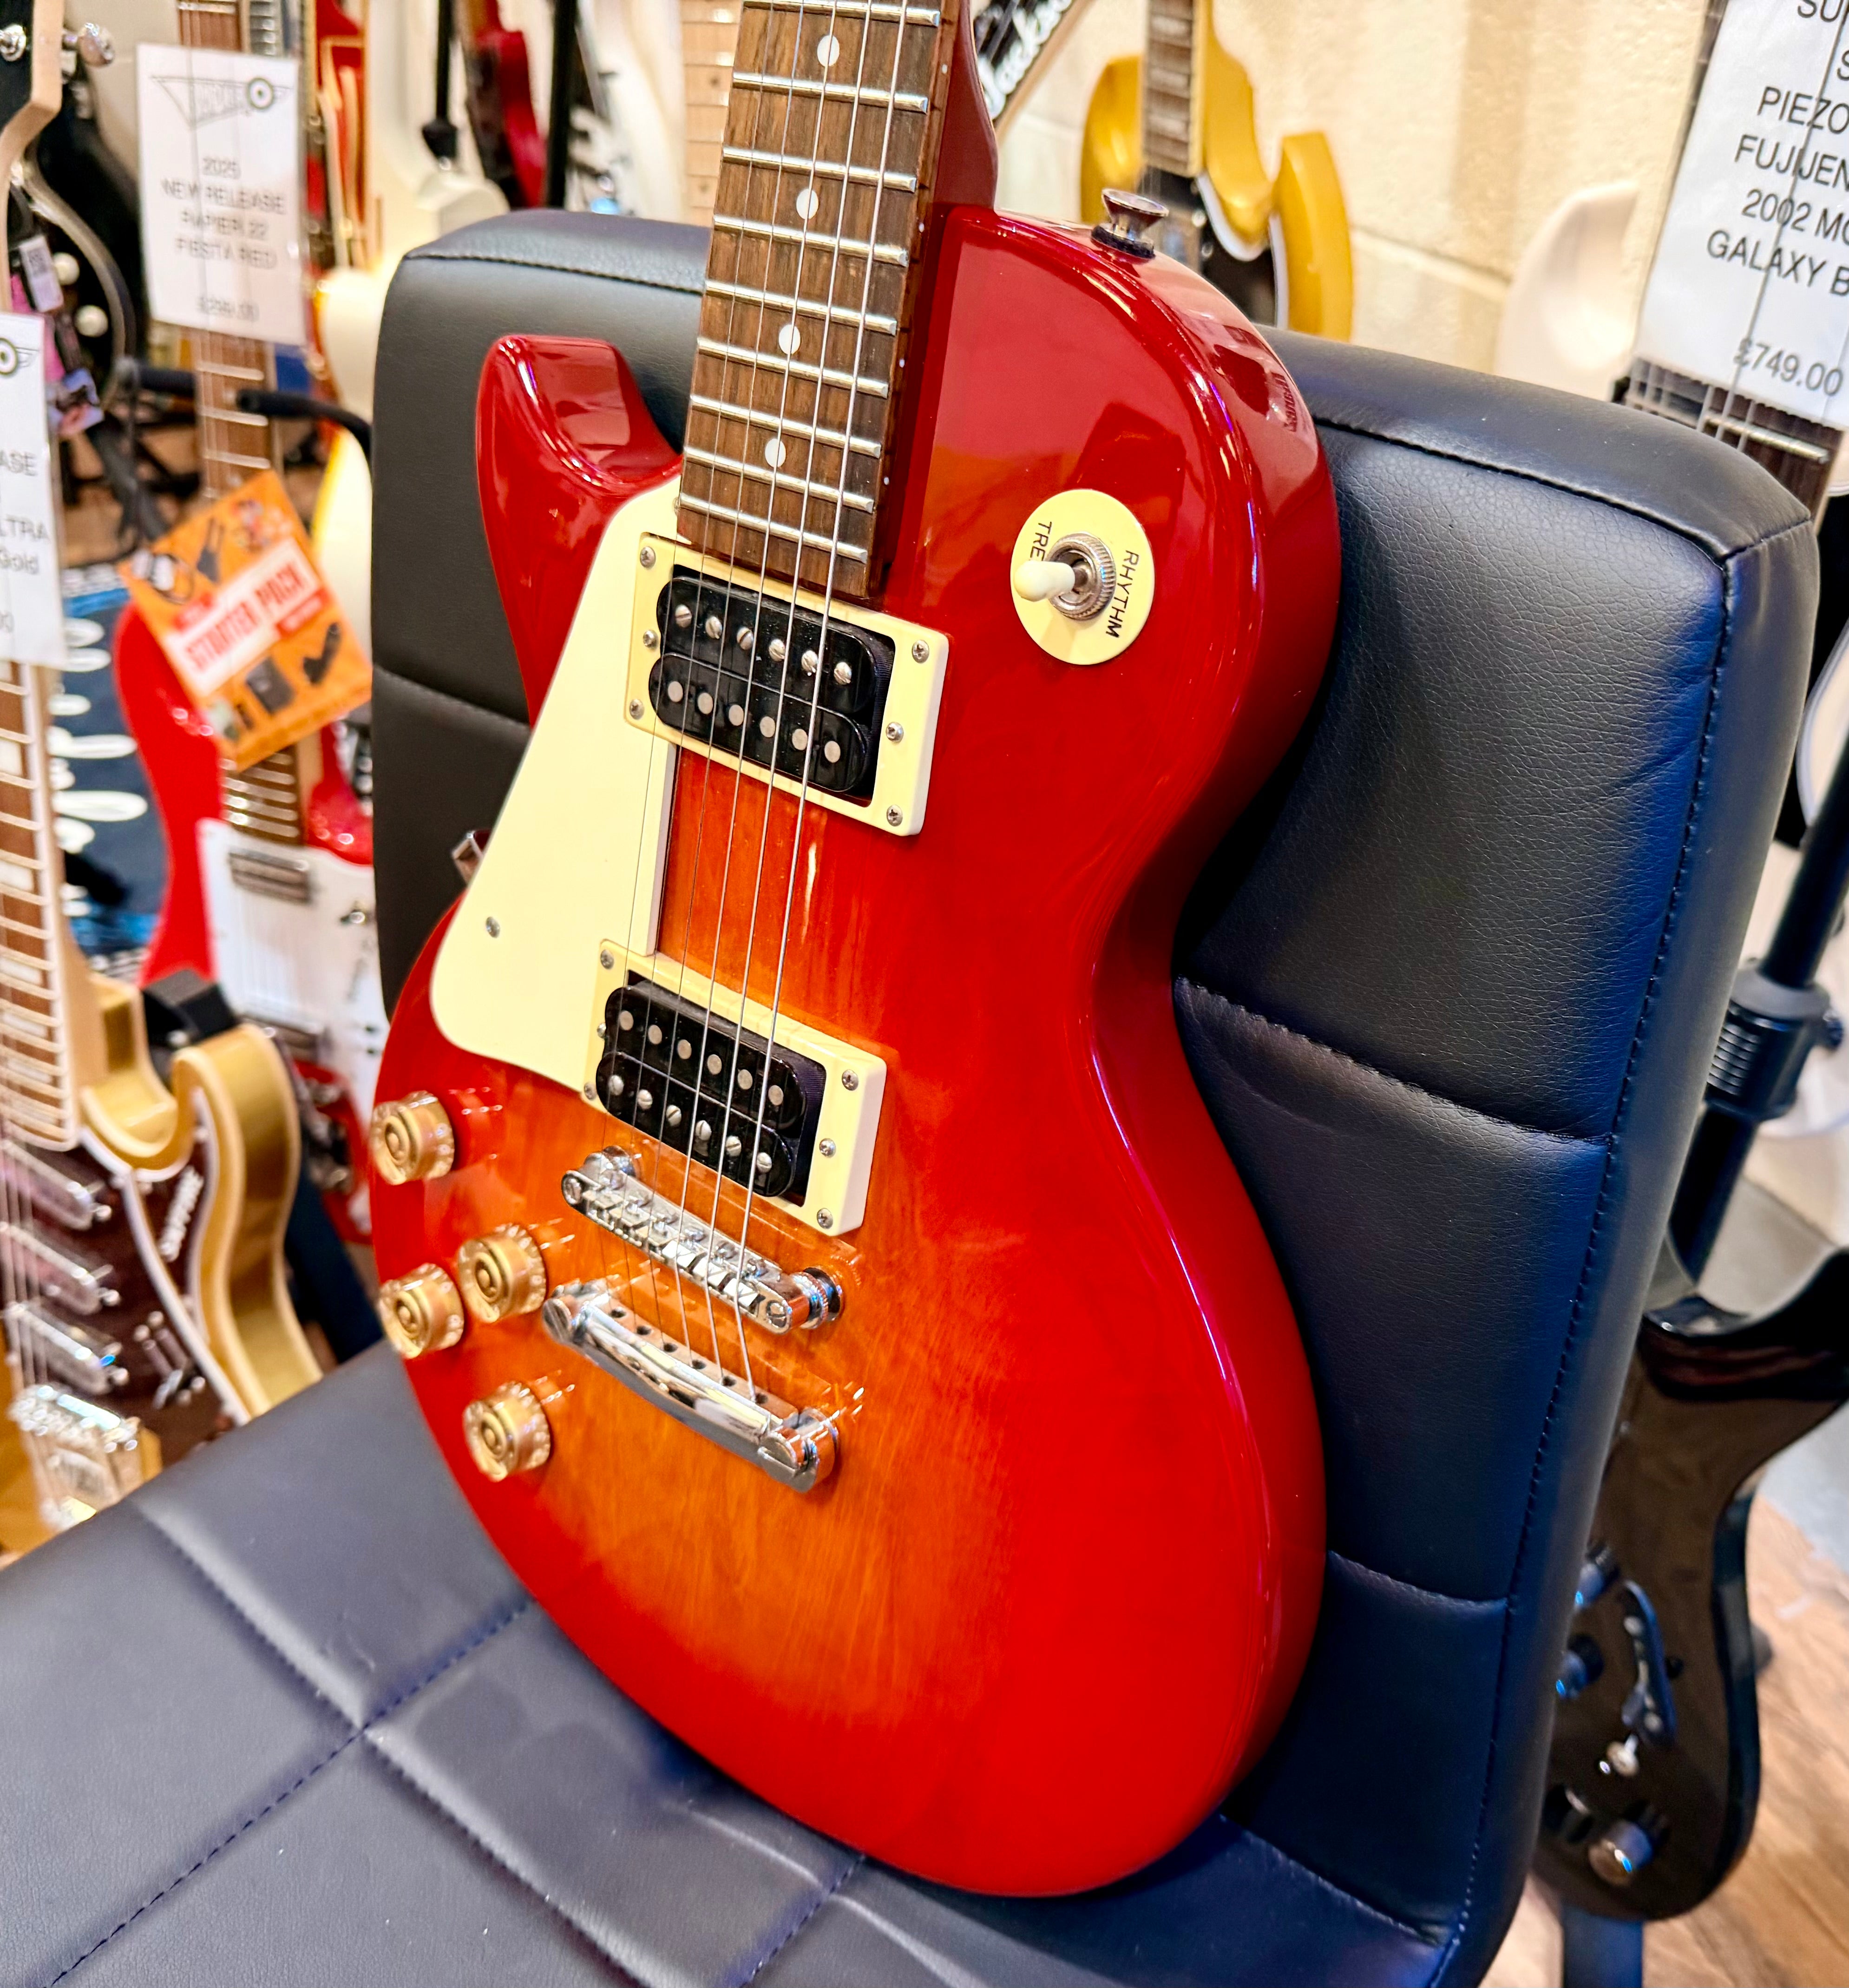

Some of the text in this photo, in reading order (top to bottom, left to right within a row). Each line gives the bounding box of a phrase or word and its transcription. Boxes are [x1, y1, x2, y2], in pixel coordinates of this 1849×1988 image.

[1798, 0, 1849, 22] SU
[1757, 85, 1849, 134] PIEZO
[203, 156, 241, 180] 2025
[1742, 188, 1812, 232] 2002
[1707, 230, 1827, 288] GALAXY
[1733, 338, 1843, 396] £749.00
[1105, 550, 1140, 638] RHYTHM
